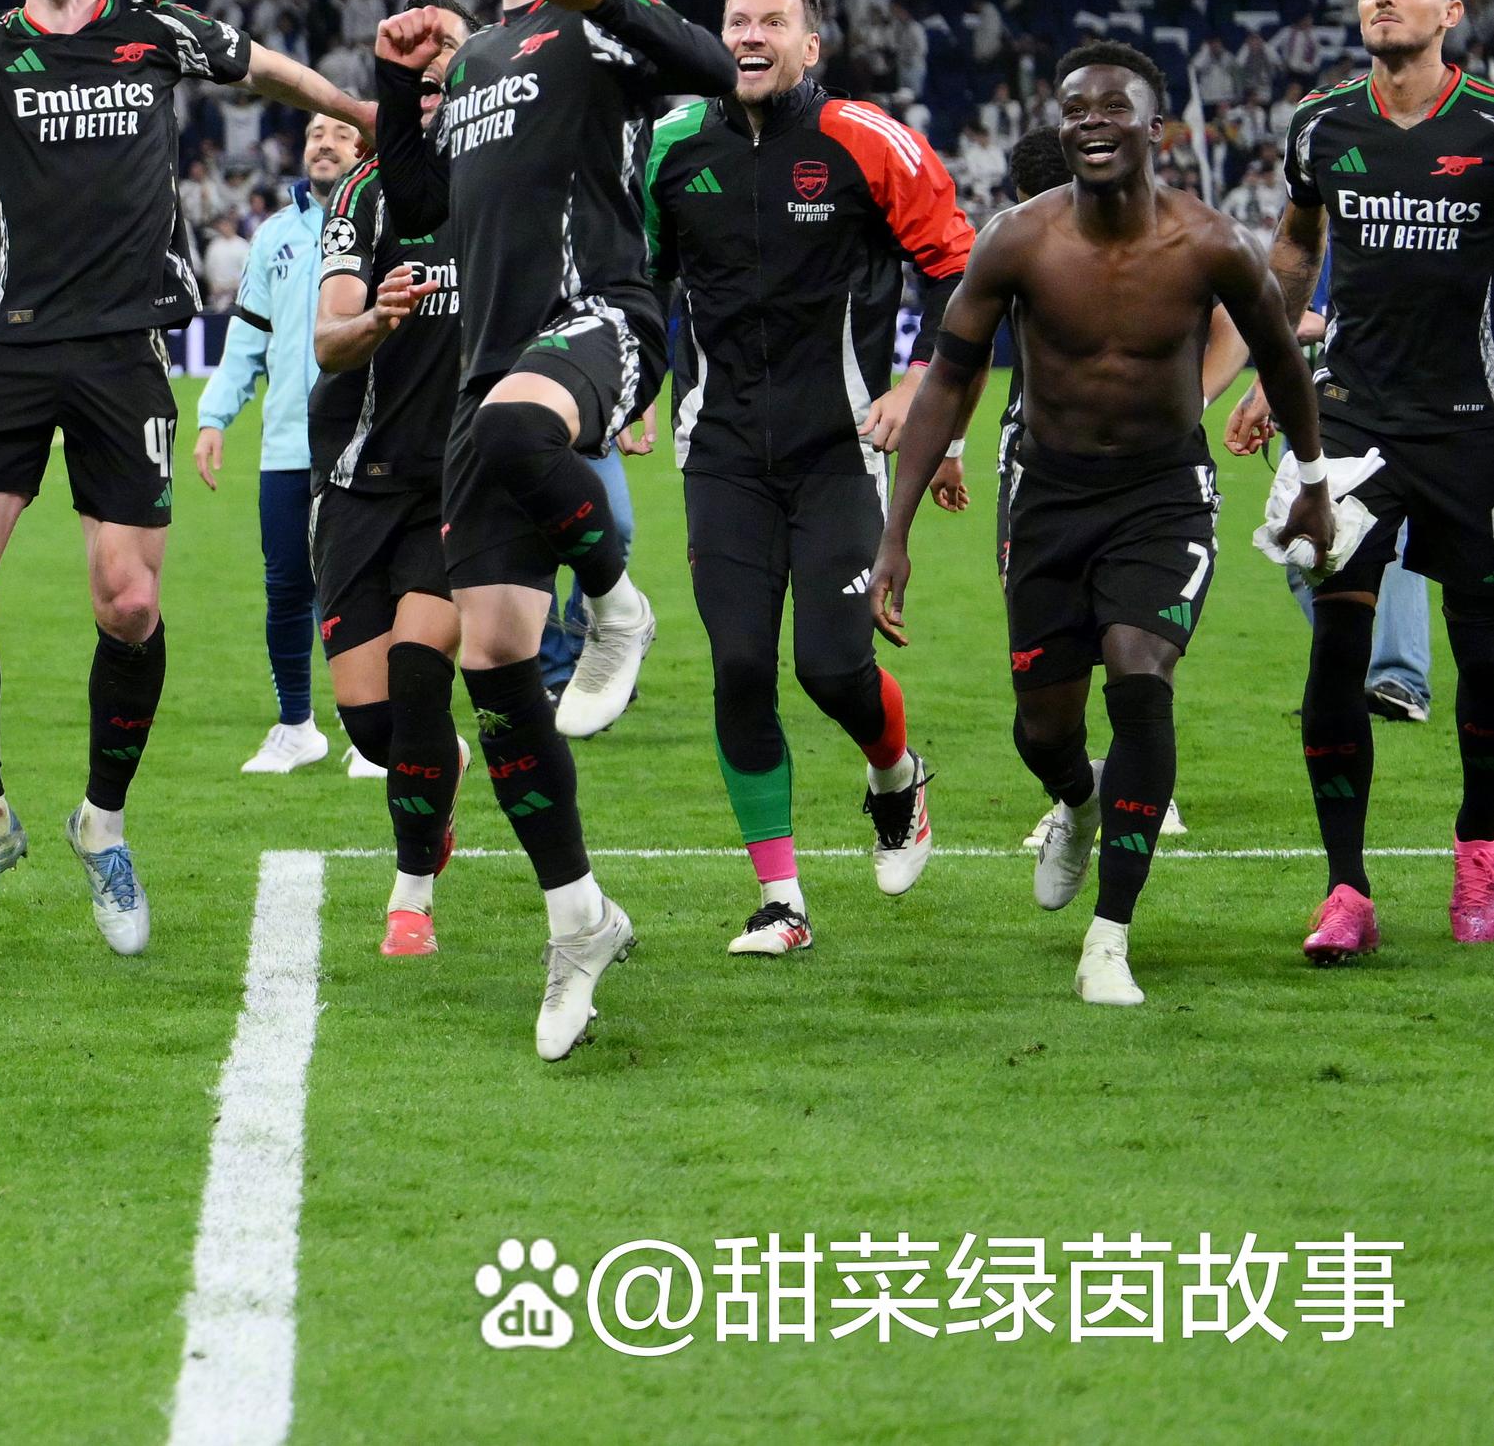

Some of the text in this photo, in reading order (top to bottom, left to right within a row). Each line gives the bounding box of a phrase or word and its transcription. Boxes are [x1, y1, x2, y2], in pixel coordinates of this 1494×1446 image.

[13, 79, 155, 119] Emirates
[39, 110, 139, 143] FLY BETTER
[464, 107, 517, 153] BETTER
[787, 201, 836, 214] Emirates
[794, 212, 829, 223] FLY BETTER
[1337, 189, 1482, 225] Emirates
[1360, 223, 1461, 252] FLY BETTER
[419, 292, 448, 316] FLY
[143, 416, 176, 479] 41
[1179, 541, 1211, 601] 7
[395, 761, 443, 780] AFC
[1113, 797, 1159, 818] AFC
